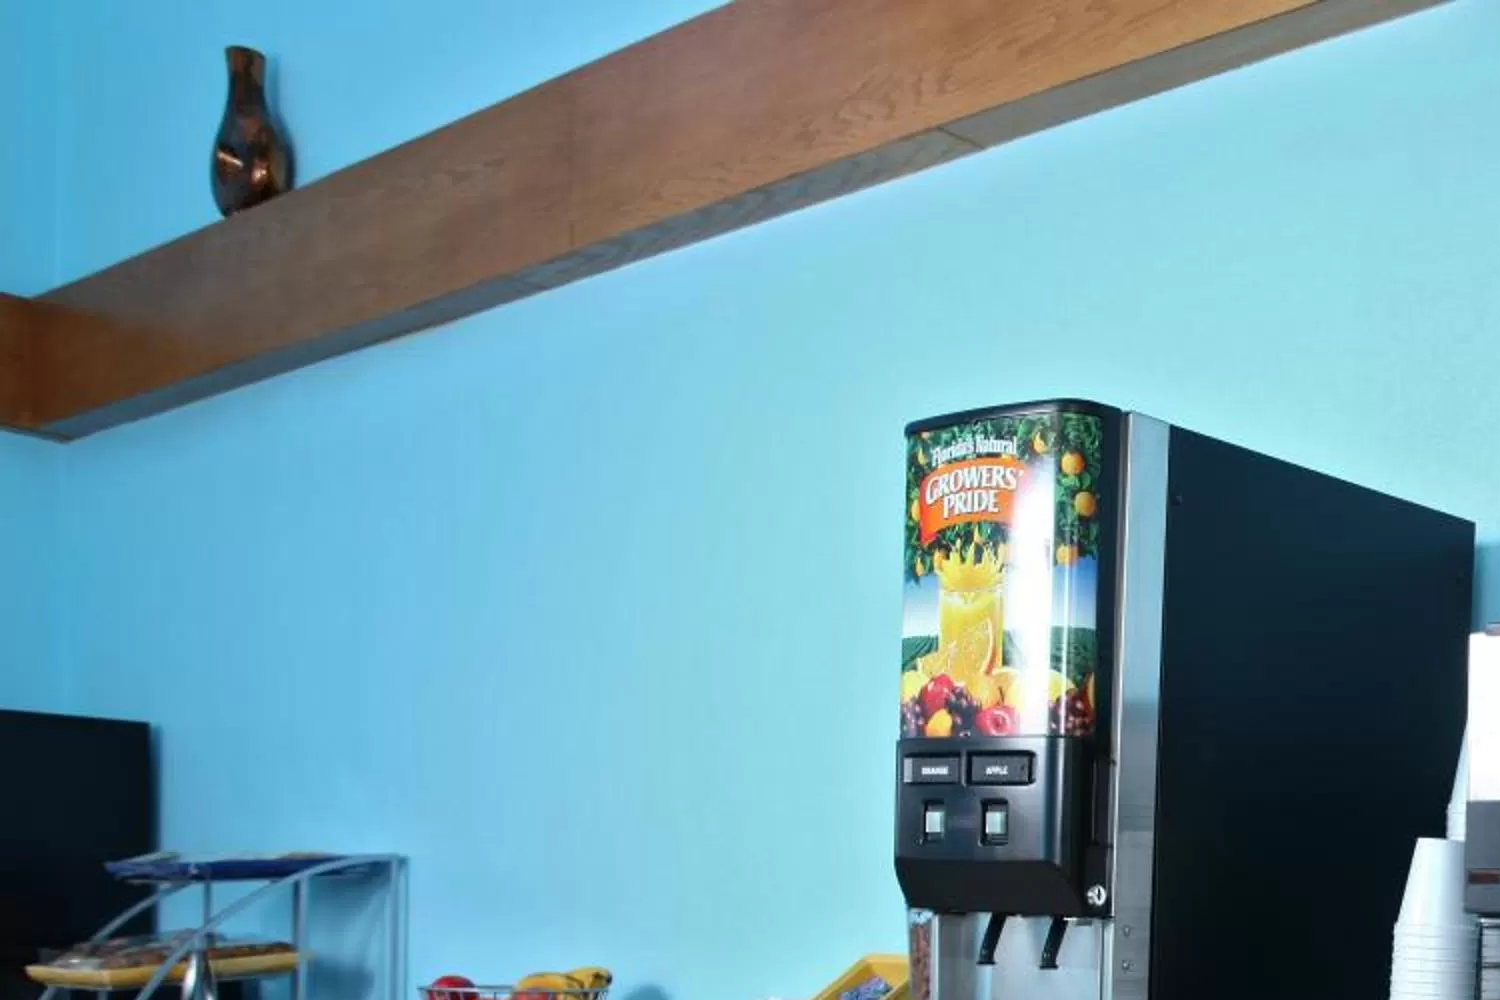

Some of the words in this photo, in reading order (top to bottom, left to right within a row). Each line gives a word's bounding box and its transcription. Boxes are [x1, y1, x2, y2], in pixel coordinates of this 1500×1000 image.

[976, 434, 1017, 454] Natural
[943, 489, 1000, 519] PRIDE
[985, 765, 1009, 775] APPLE
